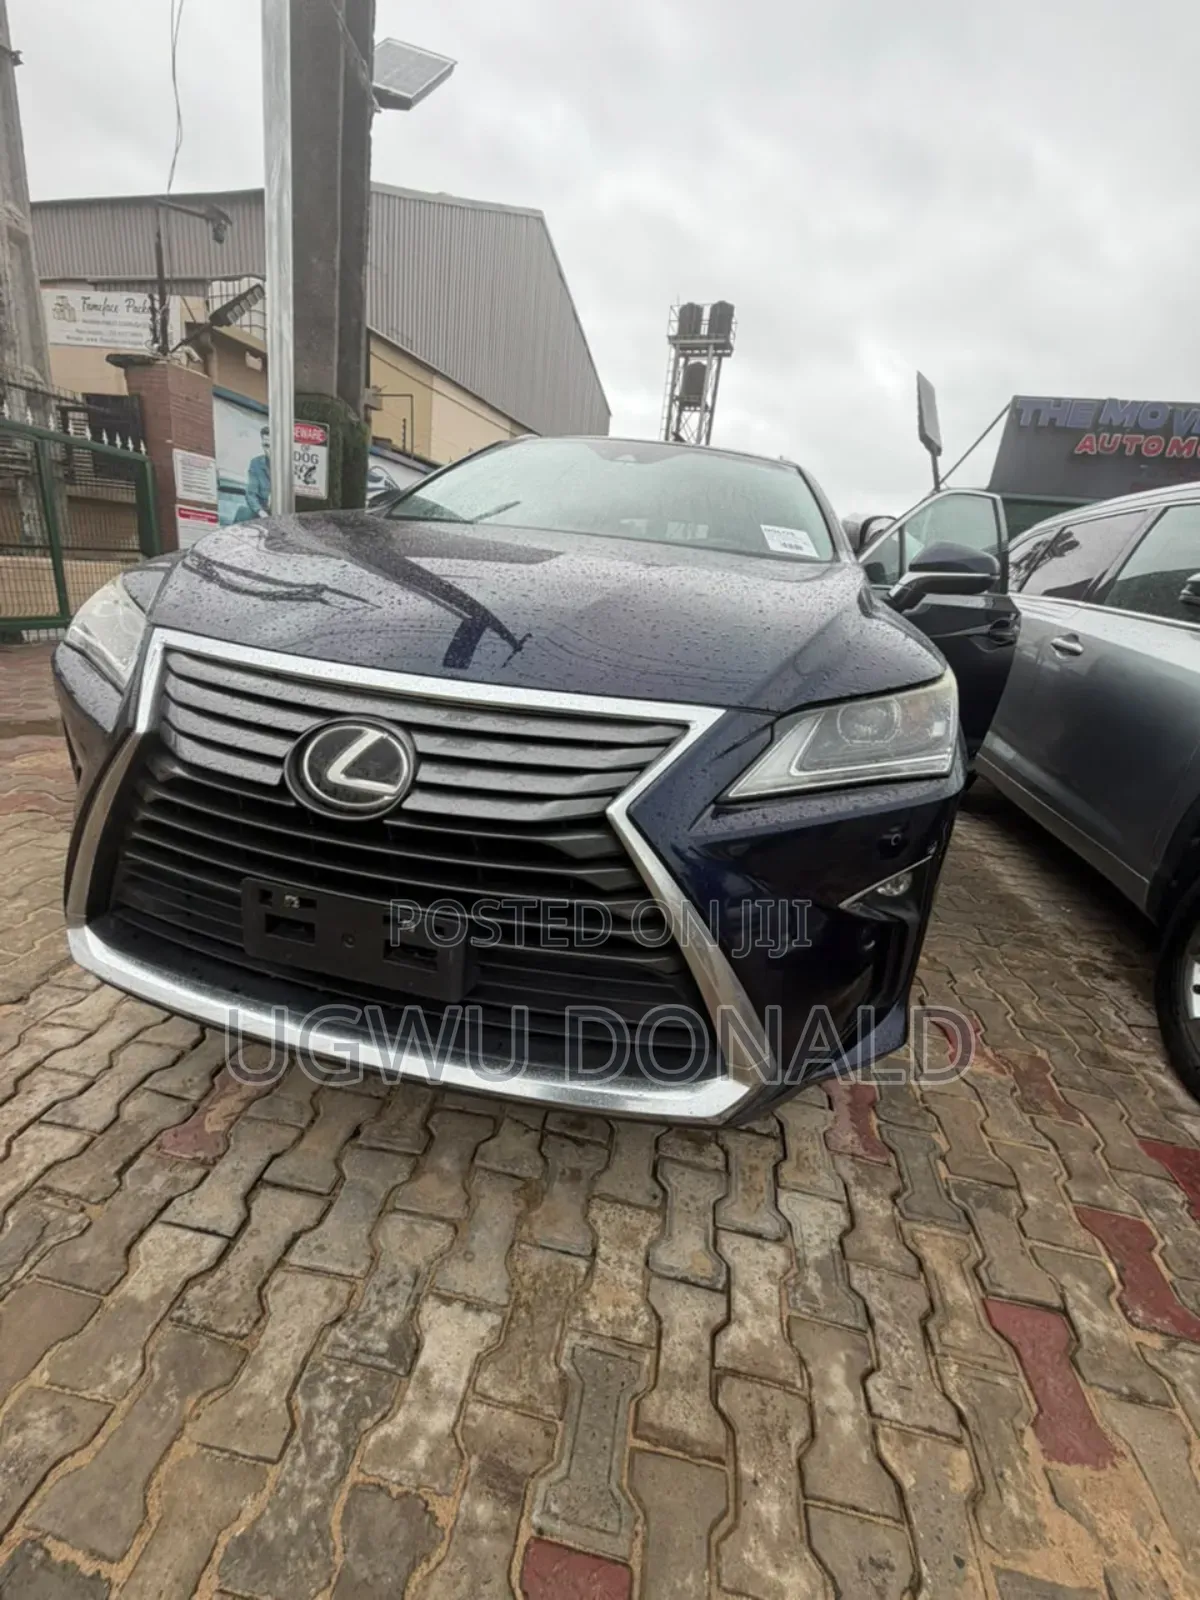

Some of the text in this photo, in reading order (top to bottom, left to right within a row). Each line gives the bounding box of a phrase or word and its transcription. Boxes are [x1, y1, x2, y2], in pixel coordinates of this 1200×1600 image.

[1018, 398, 1200, 436] THE MOV
[294, 451, 319, 465] DOG
[1075, 433, 1200, 458] AUTOM
